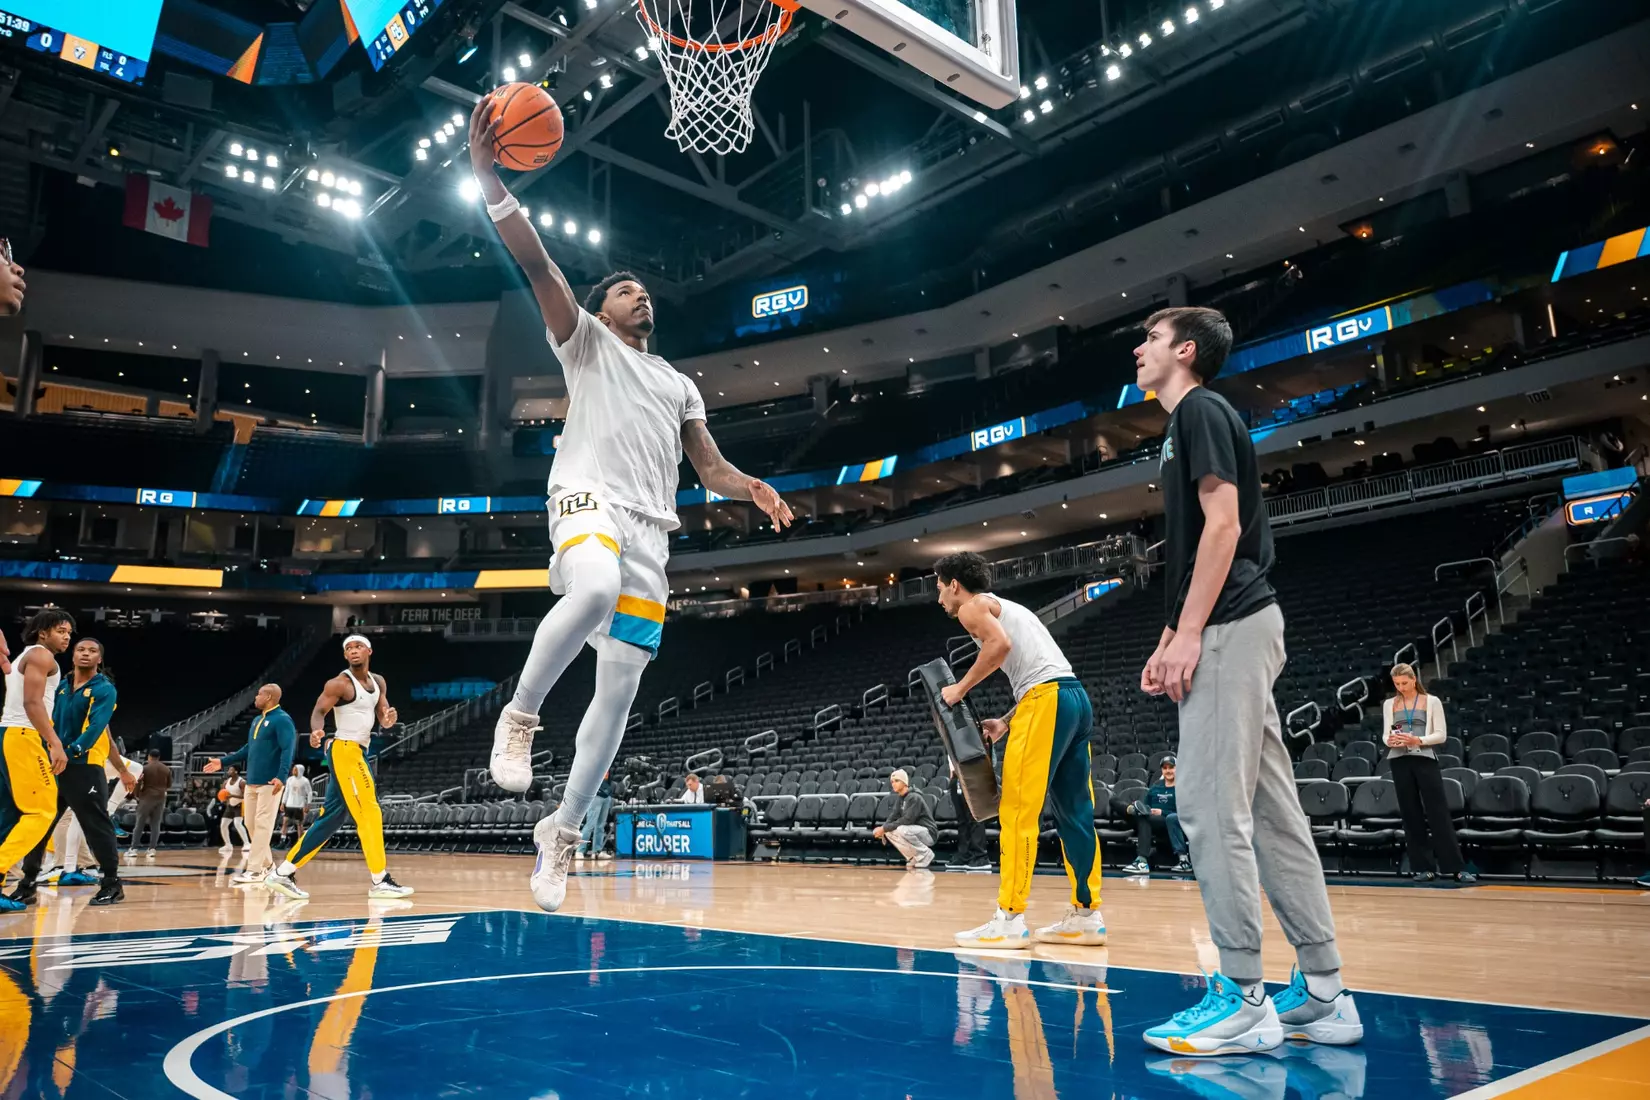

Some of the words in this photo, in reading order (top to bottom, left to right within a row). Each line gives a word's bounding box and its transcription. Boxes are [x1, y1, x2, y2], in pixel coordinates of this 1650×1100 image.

[40, 33, 53, 48] 0
[102, 50, 114, 60] FLS
[115, 67, 124, 77] 4
[756, 290, 802, 314] RGV
[401, 608, 430, 621] FEAR
[432, 608, 452, 621] THE
[454, 607, 481, 620] DEER
[635, 834, 691, 853] GRUBER
